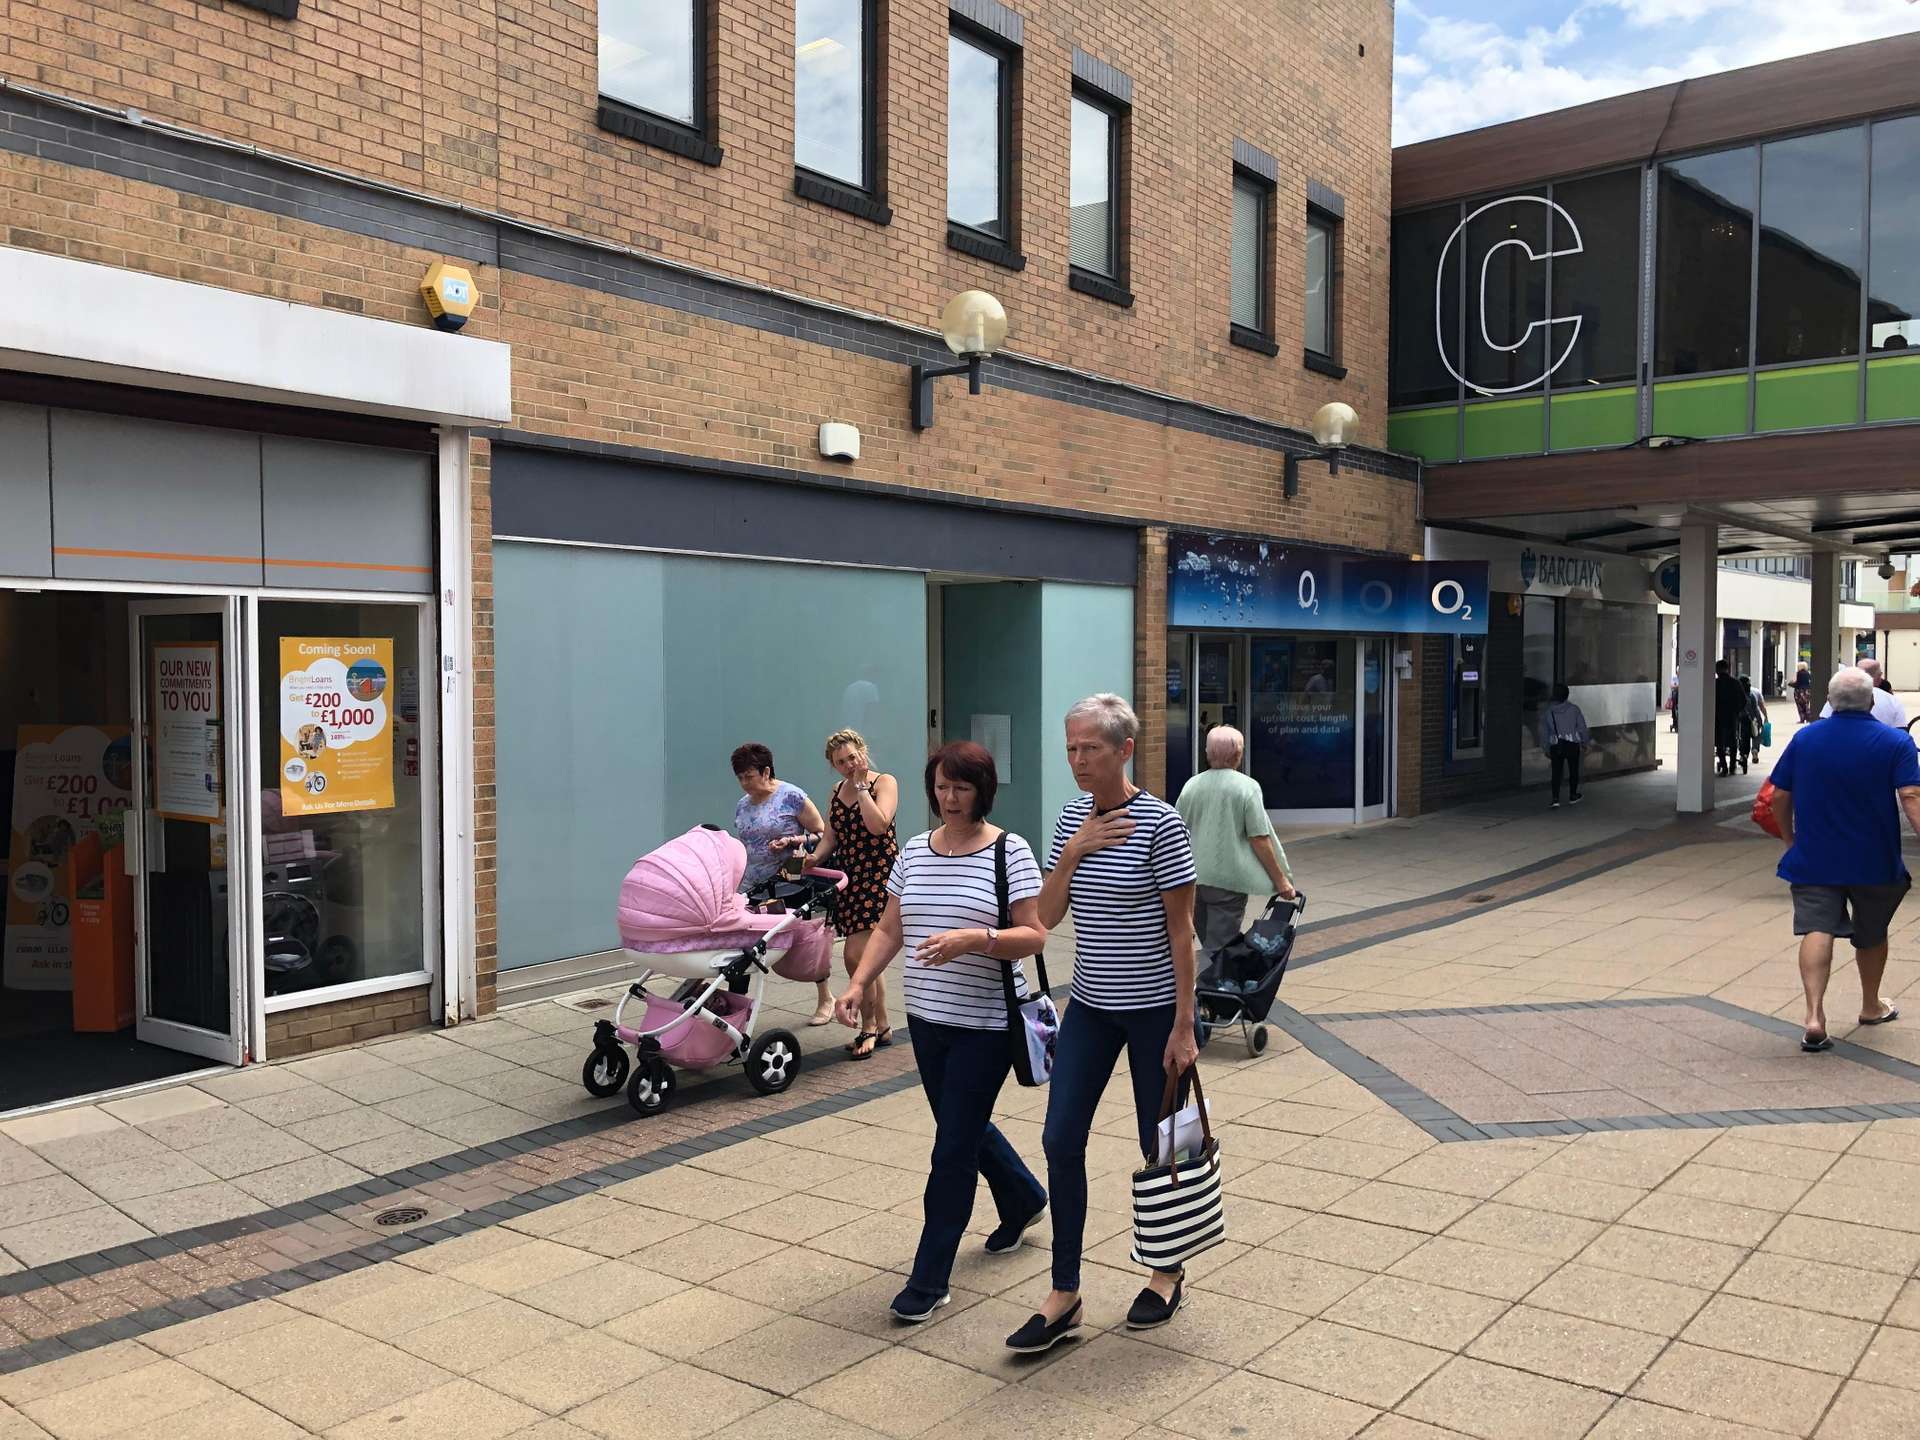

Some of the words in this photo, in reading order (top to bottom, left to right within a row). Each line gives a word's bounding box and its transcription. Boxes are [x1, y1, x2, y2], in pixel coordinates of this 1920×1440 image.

[1436, 195, 1584, 393] C
[1538, 554, 1602, 588] BARCLAYS
[1431, 580, 1472, 620] O2
[298, 643, 341, 657] Coming
[343, 644, 376, 656] Soon!
[160, 660, 183, 677] OUR
[187, 660, 212, 677] NEW
[160, 678, 212, 690] COMMITMENTS
[161, 691, 179, 711] TO
[182, 690, 211, 713] YOU
[288, 693, 305, 702] Get
[305, 692, 341, 708] £200
[1312, 704, 1332, 713] your
[320, 707, 375, 729] £1,000
[1319, 713, 1348, 724] length
[1268, 725, 1278, 734] of
[1280, 725, 1300, 736] plan
[1301, 725, 1318, 734] and
[1320, 725, 1341, 734] data
[47, 774, 98, 795] £200
